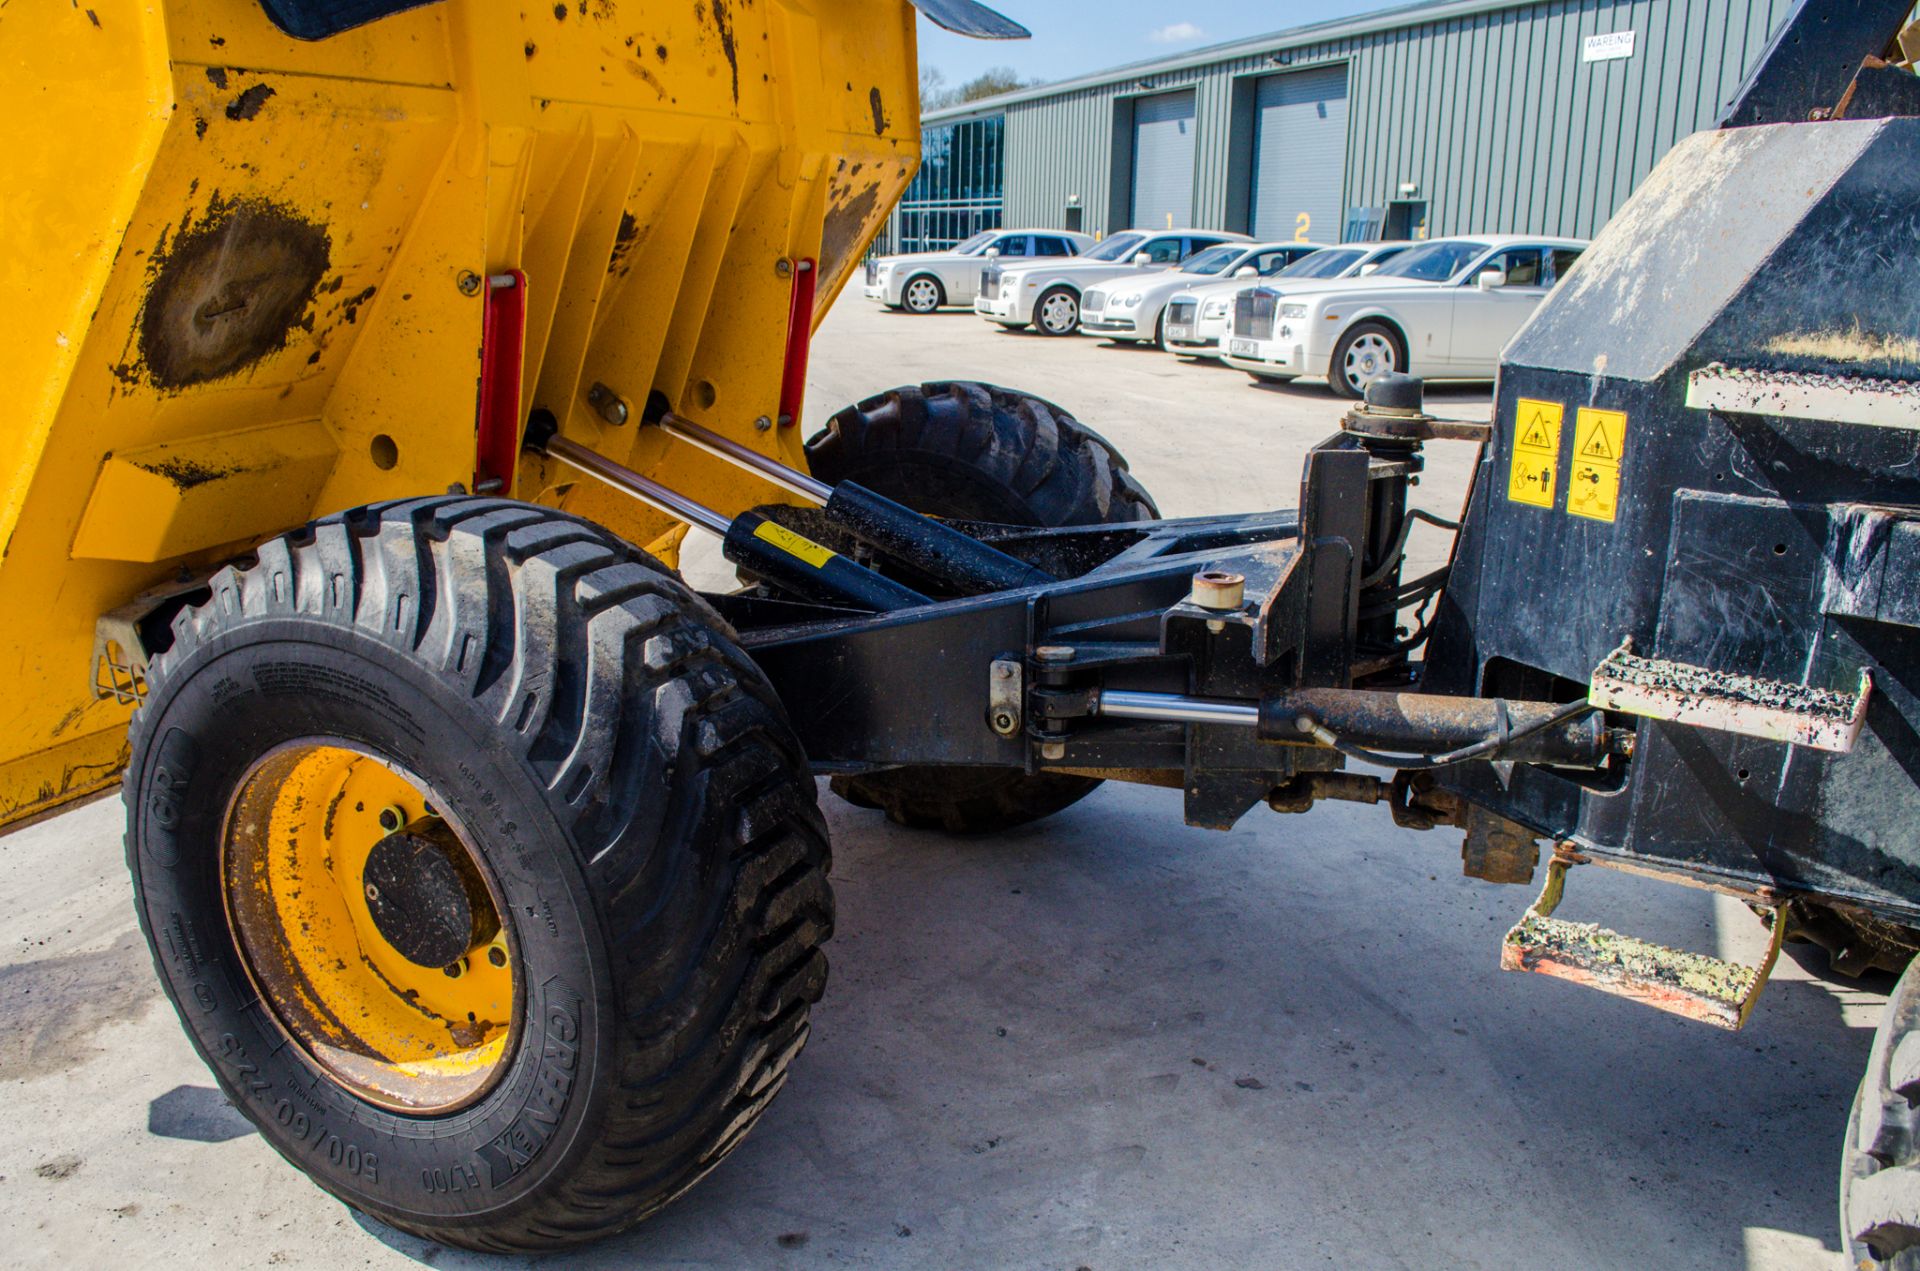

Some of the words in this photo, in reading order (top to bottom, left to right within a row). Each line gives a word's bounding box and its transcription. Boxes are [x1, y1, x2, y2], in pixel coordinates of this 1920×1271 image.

[1587, 32, 1632, 48] WAREING
[1295, 212, 1311, 242] 2
[494, 1004, 578, 1176] GREENEX
[421, 1161, 481, 1195] FL700
